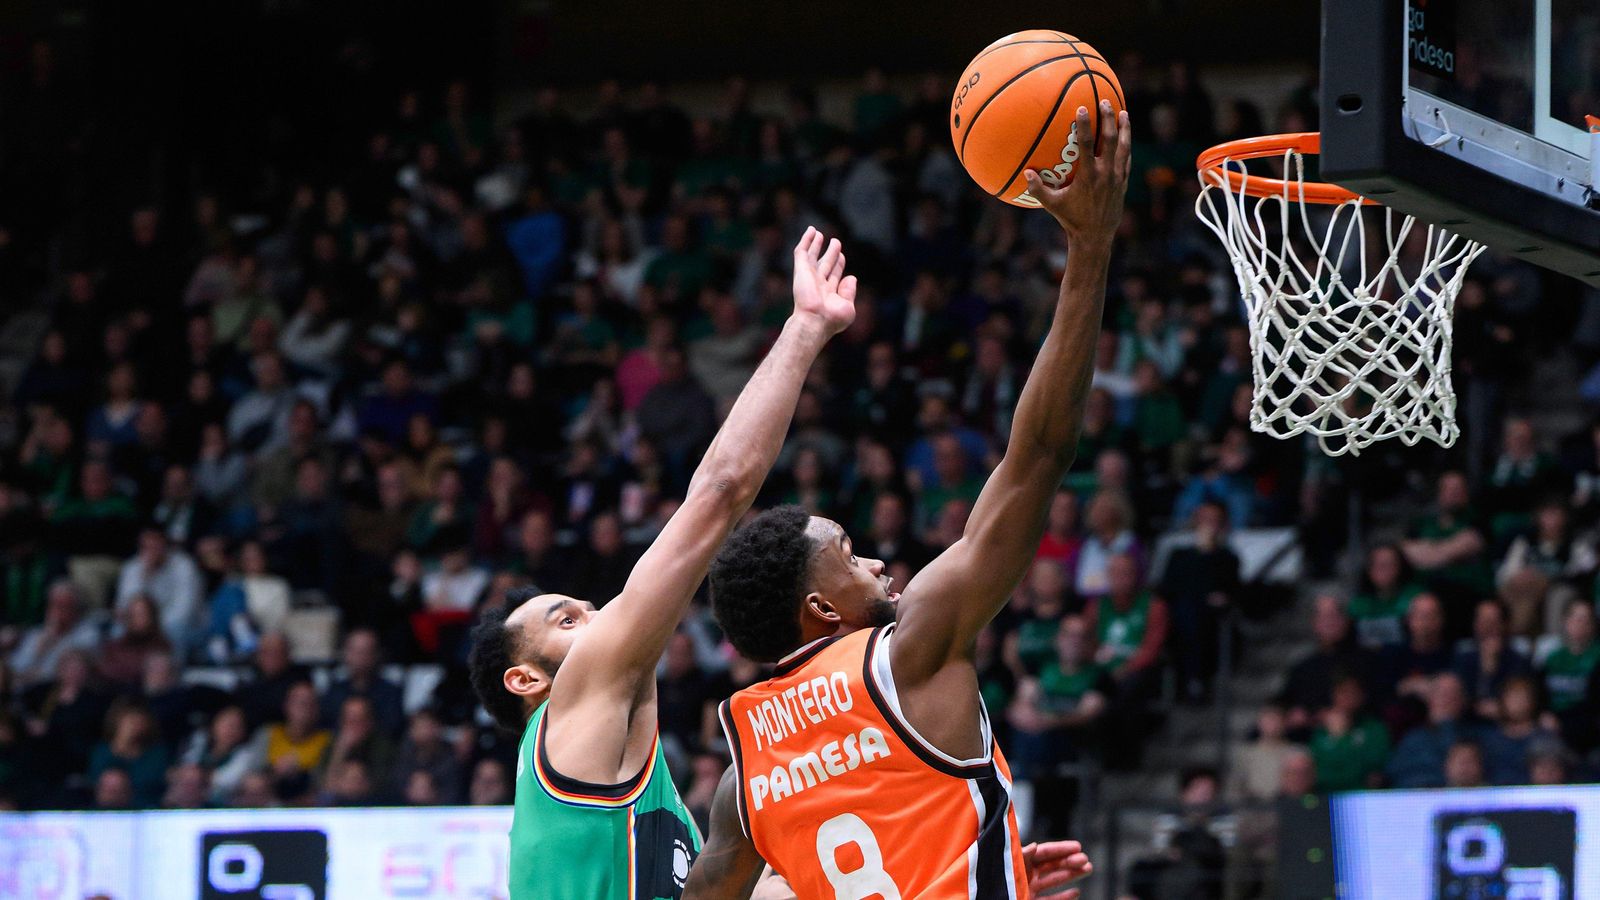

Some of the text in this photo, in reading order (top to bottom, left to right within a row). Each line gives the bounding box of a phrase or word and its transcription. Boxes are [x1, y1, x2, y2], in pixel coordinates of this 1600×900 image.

[747, 671, 853, 751] MONTERO
[750, 727, 892, 811] PAMESA
[816, 813, 902, 900] 8
